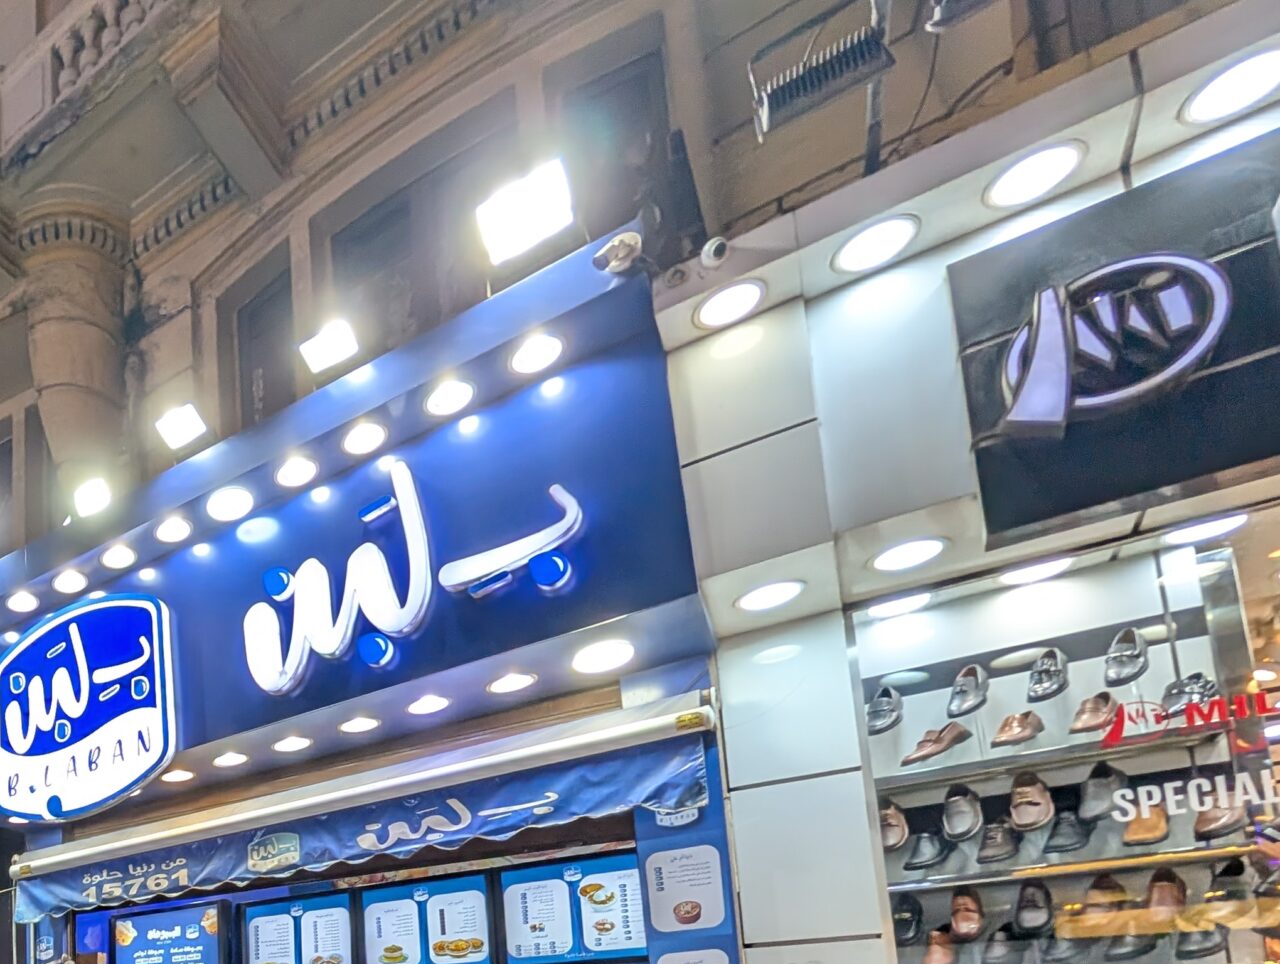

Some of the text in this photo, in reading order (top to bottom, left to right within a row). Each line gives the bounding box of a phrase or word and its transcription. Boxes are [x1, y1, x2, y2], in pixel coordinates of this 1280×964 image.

[1111, 768, 1280, 823] SPECIAL
[81, 868, 189, 903] 15761
[82, 857, 187, 885] من دنيا حلوة
